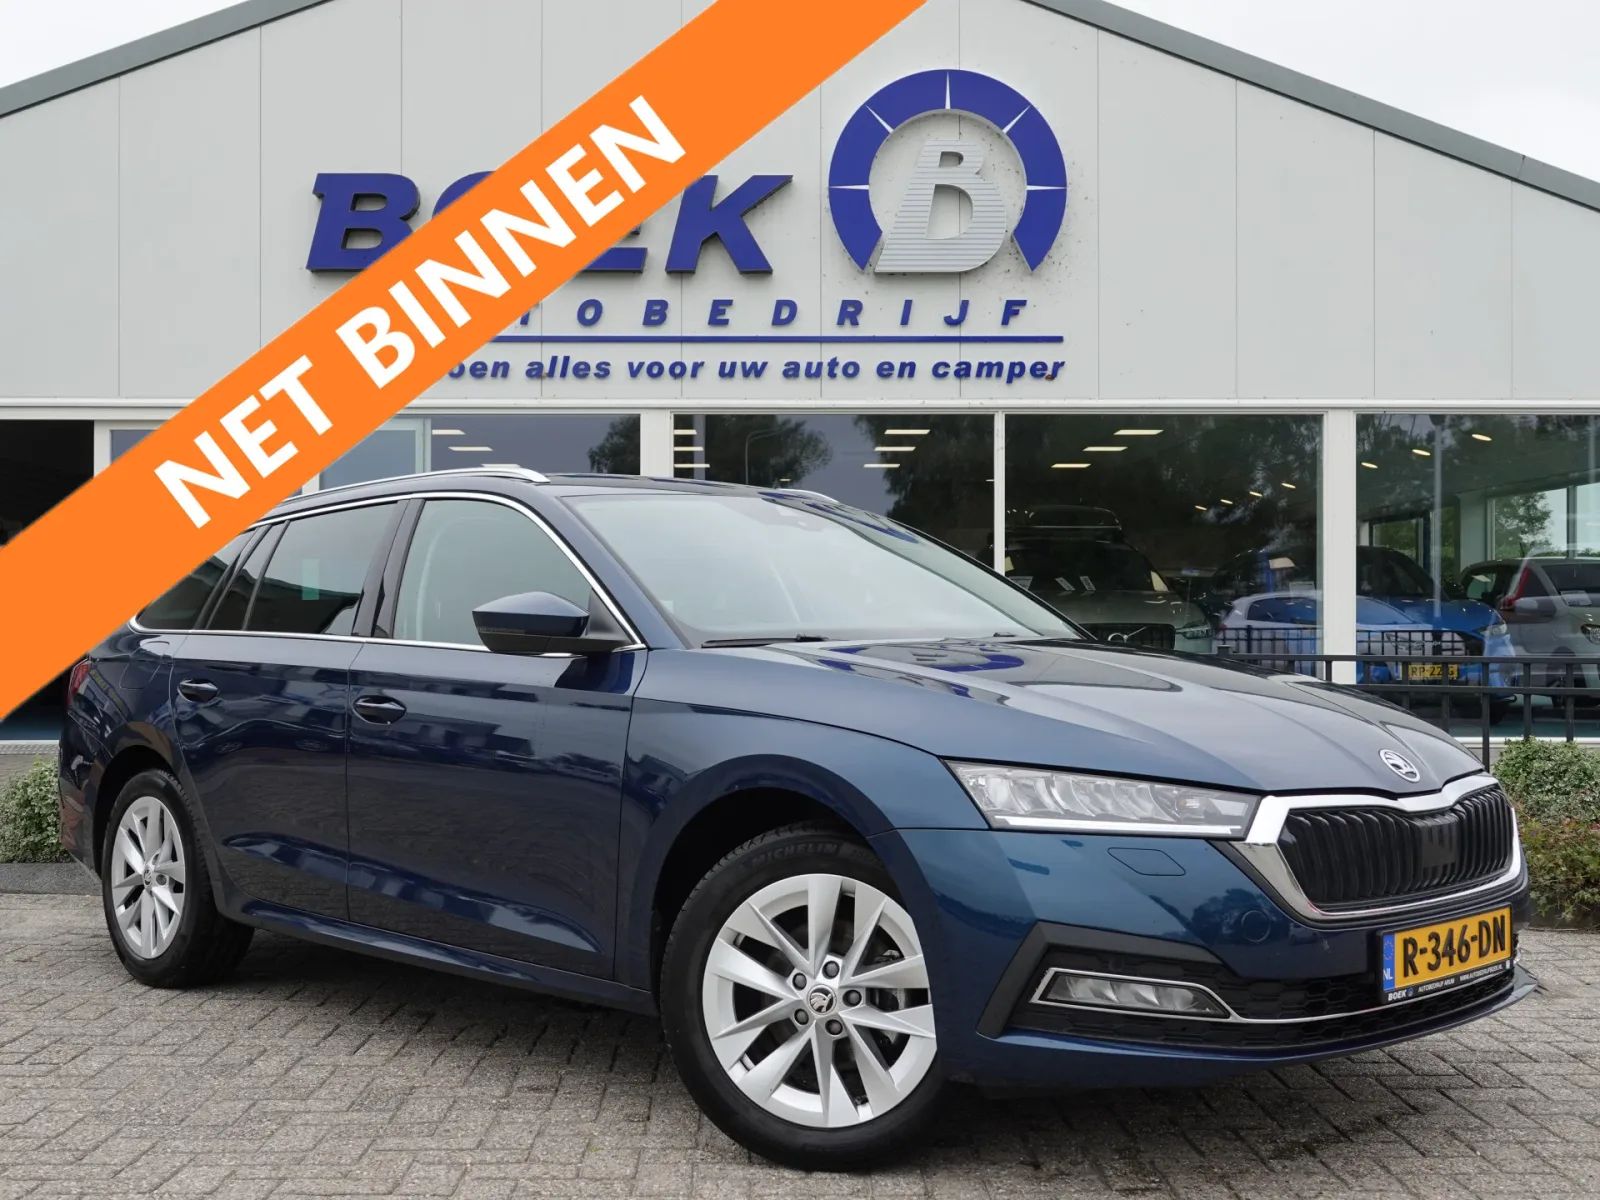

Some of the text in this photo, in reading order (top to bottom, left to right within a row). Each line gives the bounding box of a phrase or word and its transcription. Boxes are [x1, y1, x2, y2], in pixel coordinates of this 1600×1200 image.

[306, 172, 792, 275] BK
[519, 298, 1027, 327] OBEDRIJF
[525, 355, 610, 379] alles
[627, 361, 703, 379] voor
[718, 361, 768, 378] uw
[782, 357, 861, 379] auto
[876, 361, 917, 378] en
[932, 361, 1065, 385] camper
[753, 843, 838, 866] MICHELIN
[1403, 914, 1505, 977] R-346-DN
[1383, 968, 1394, 980] NL
[1388, 989, 1408, 1002] BOEK
